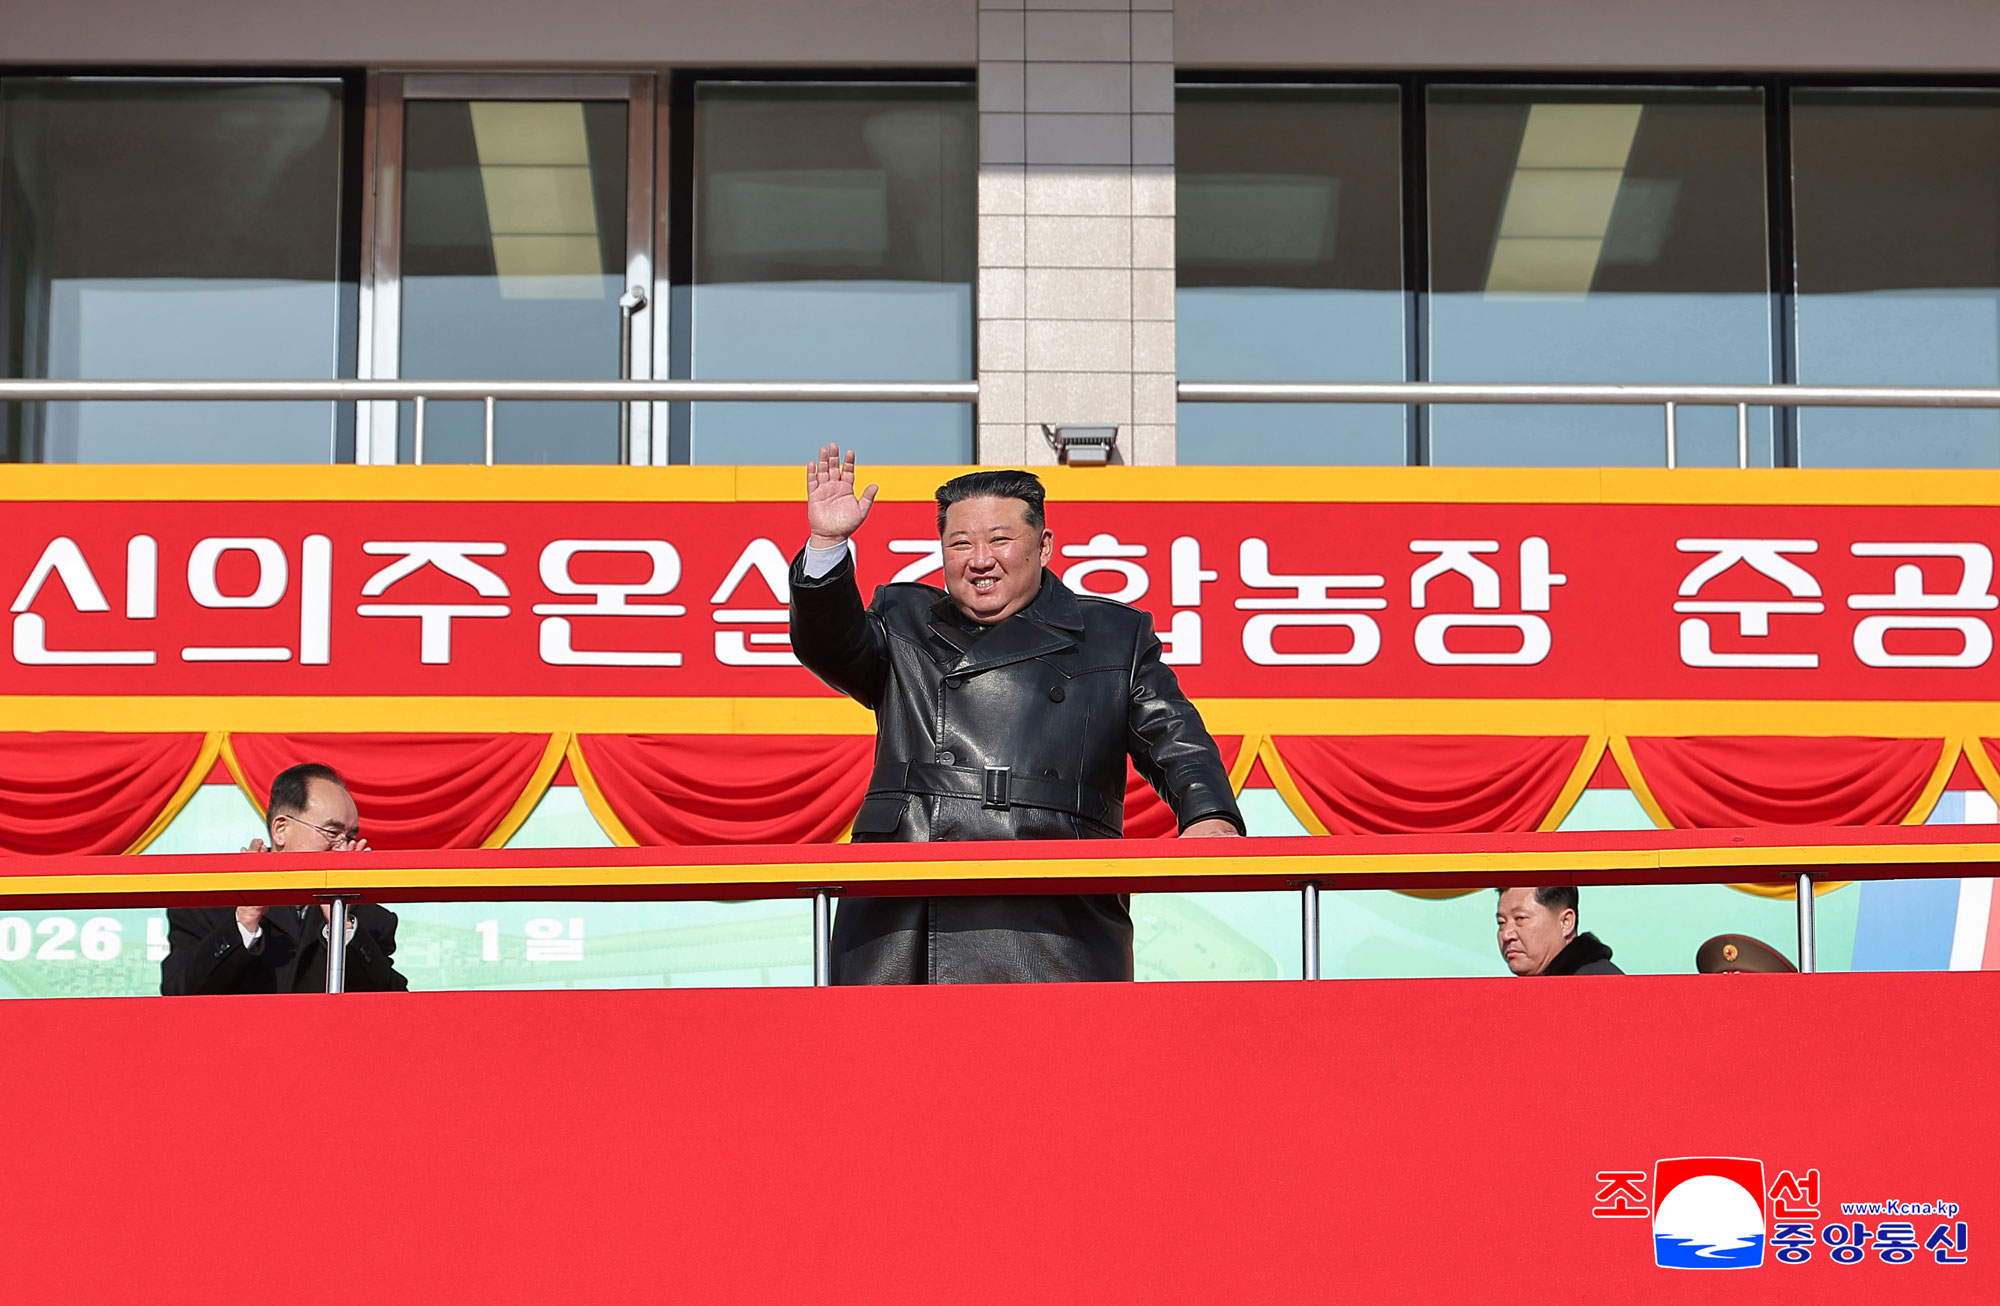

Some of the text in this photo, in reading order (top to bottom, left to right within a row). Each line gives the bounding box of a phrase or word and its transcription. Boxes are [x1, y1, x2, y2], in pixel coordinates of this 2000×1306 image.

[9, 533, 2000, 668] 신의주온실합농장 준공
[475, 917, 585, 962] 1 일
